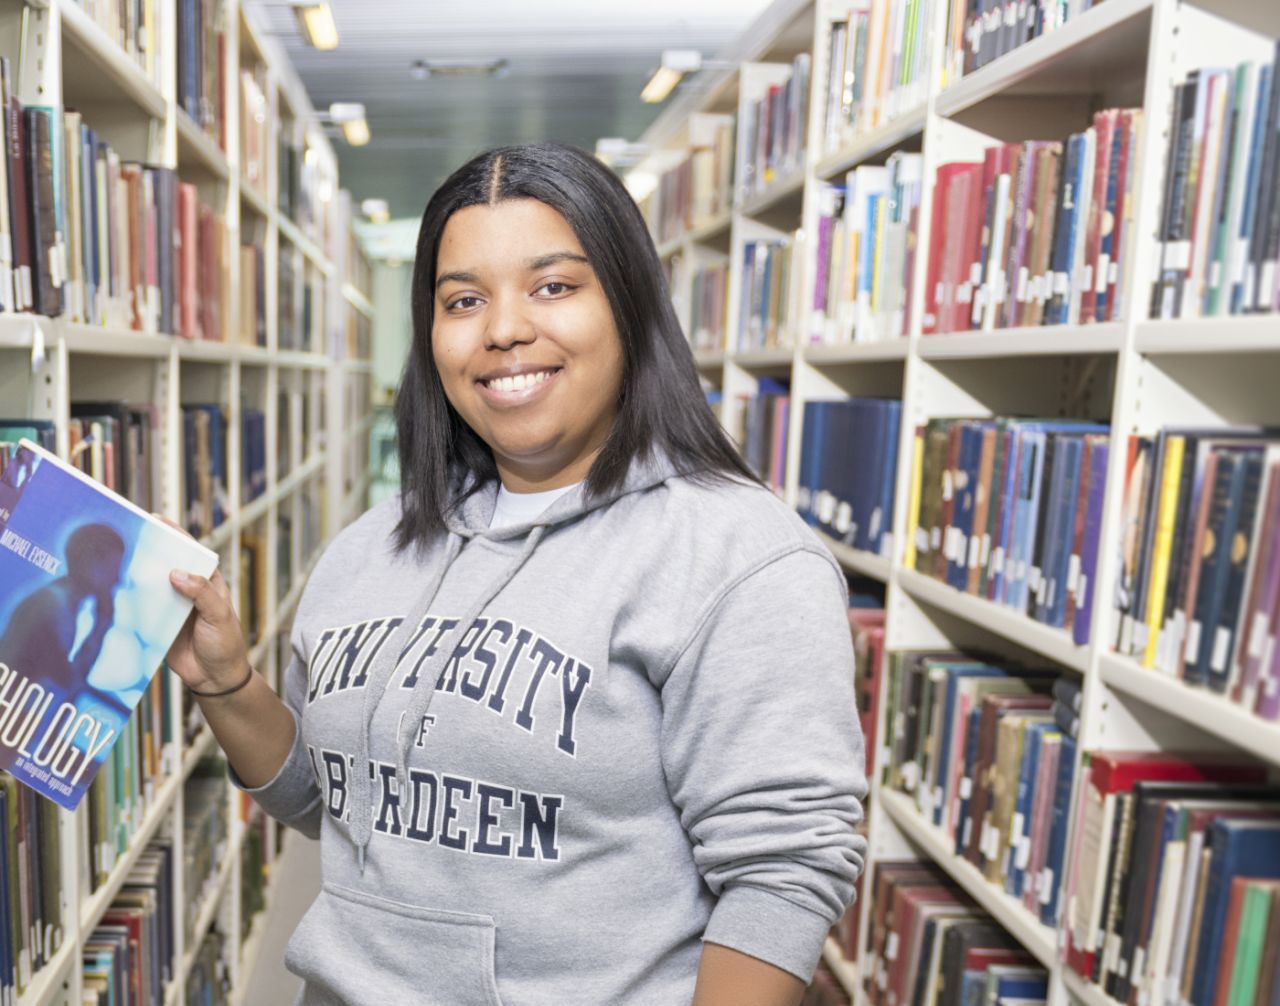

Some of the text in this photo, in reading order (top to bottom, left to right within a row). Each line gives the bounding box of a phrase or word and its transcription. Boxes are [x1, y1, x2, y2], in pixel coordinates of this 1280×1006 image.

[0, 528, 32, 559] MICHAEL
[47, 776, 74, 798] approach
[307, 744, 565, 862] BRDEEN
